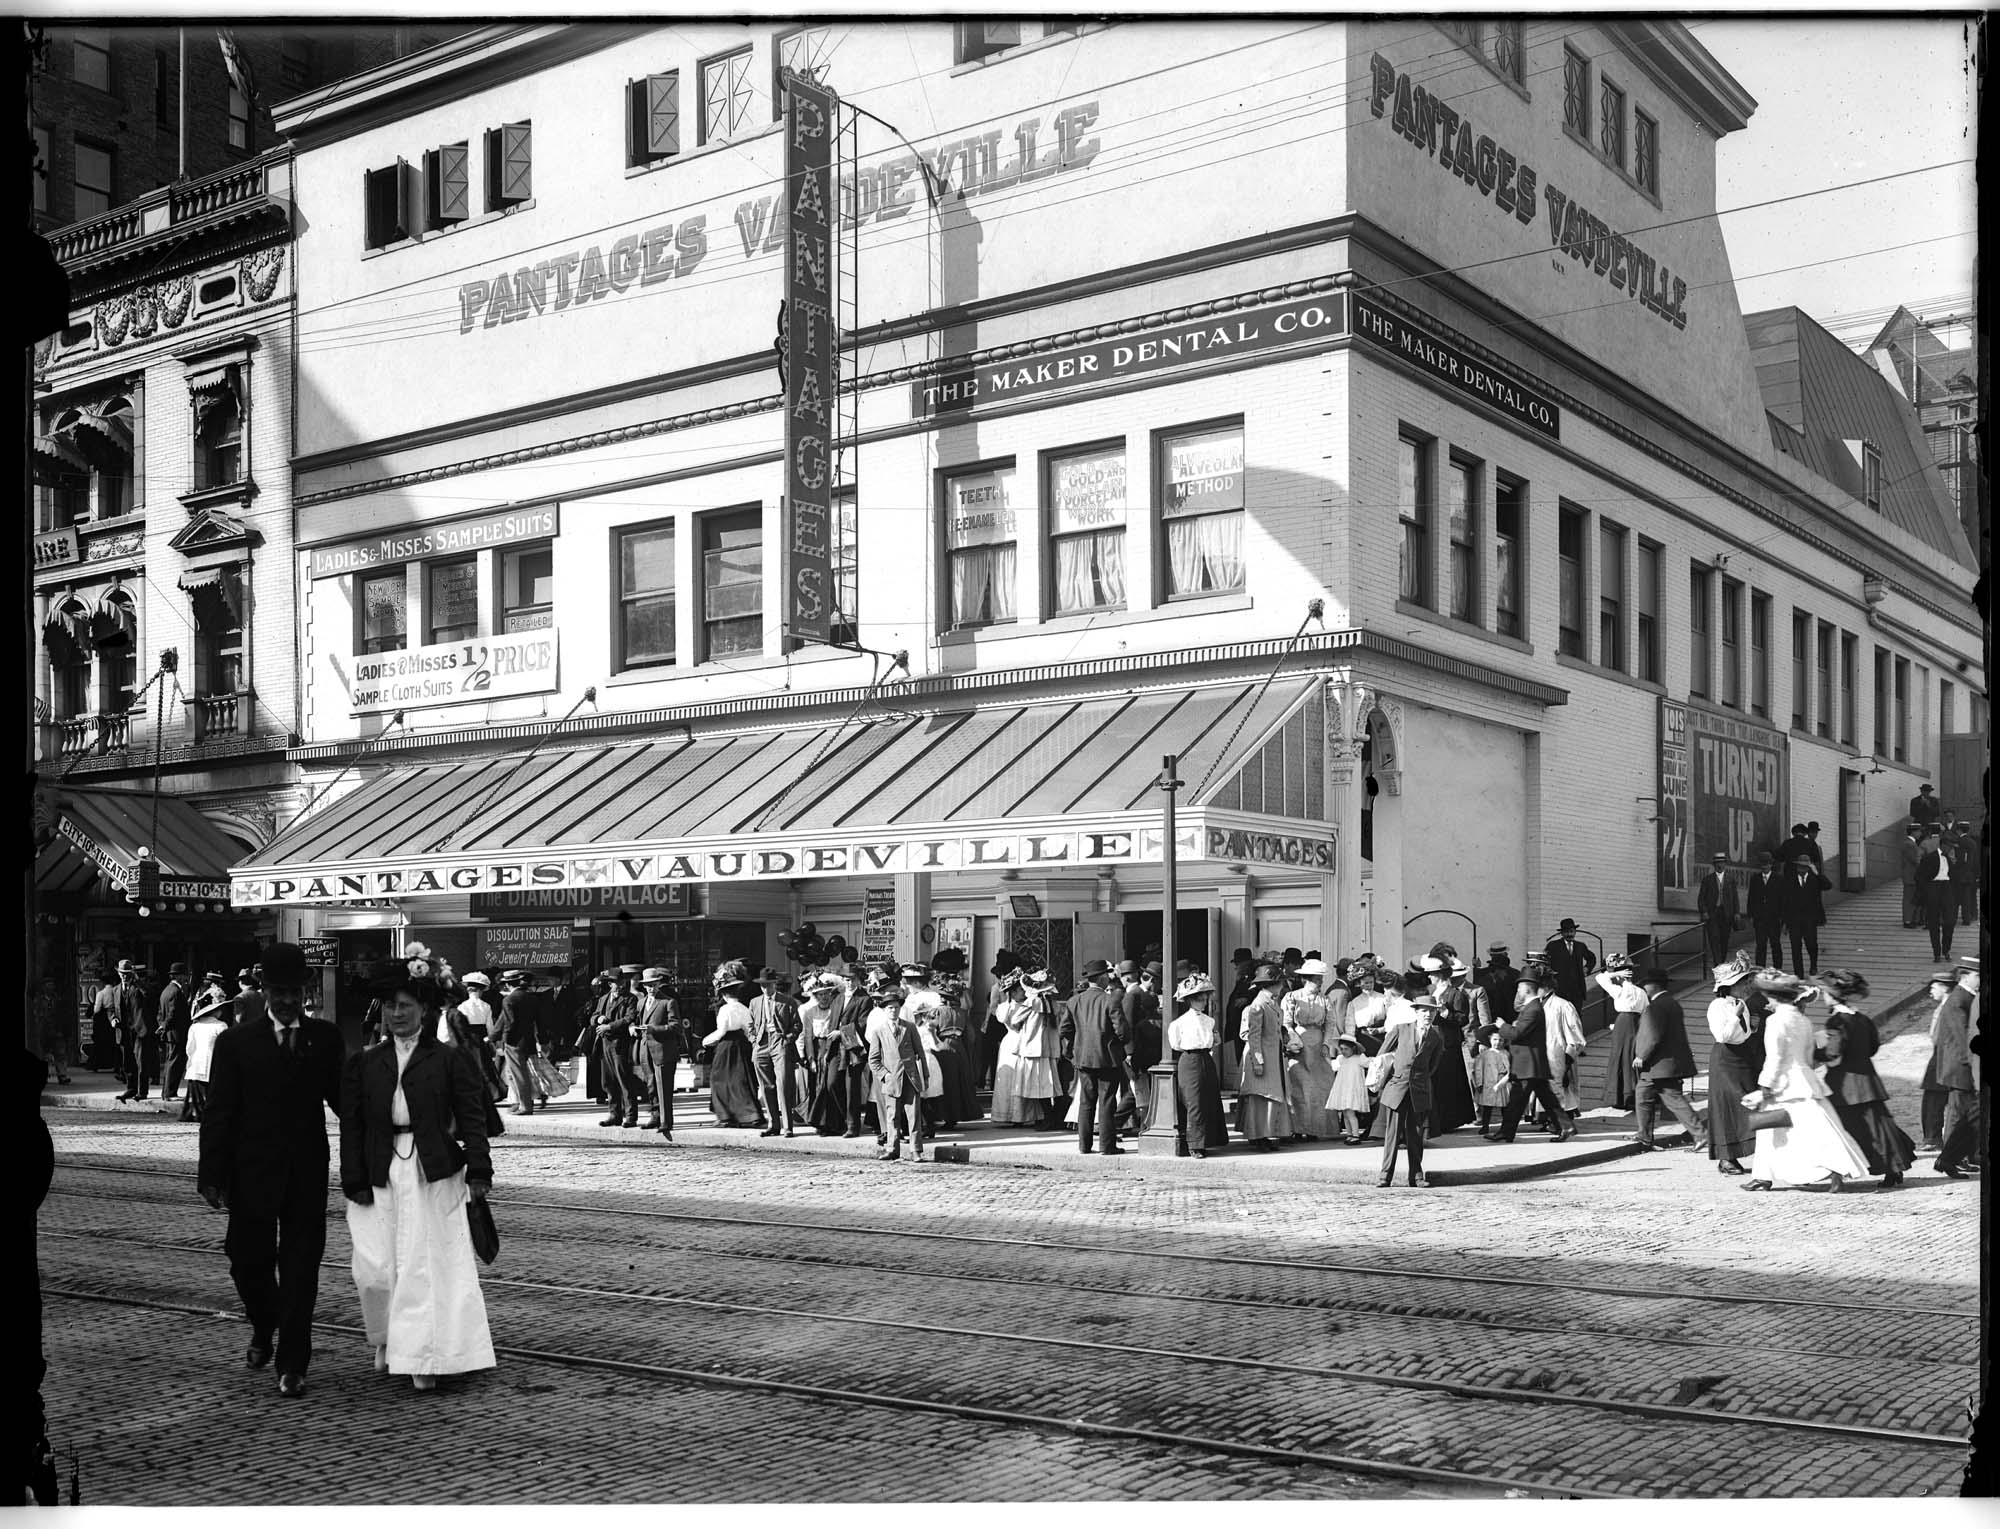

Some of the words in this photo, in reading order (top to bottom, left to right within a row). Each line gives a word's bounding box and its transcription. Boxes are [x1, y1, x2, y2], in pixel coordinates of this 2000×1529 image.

[1370, 52, 1536, 226] PANTAGES
[1545, 183, 1687, 331] VAUDEVILLE
[461, 214, 707, 334] PANTAGES
[736, 100, 1100, 258] VDEVILLE
[793, 93, 828, 621] PANTAGES
[922, 378, 979, 406] THE
[992, 354, 1099, 391] MAKER
[1112, 322, 1259, 368] DENTAL
[1274, 306, 1333, 335] CO.
[1359, 306, 1393, 342] THE
[1401, 329, 1459, 378] MAKER
[1464, 364, 1525, 412] DENTAL
[1529, 401, 1553, 428] CO.
[1176, 476, 1233, 498] METHOD
[316, 547, 368, 573] LADIES
[381, 535, 432, 560] MISSES
[436, 526, 502, 551] SAMPLE
[505, 512, 553, 538] SUITS
[510, 616, 548, 629] RETAILED
[356, 661, 396, 681] LADIES
[409, 653, 457, 674] MISSES
[493, 641, 551, 677] PRICE
[353, 688, 390, 706] SAMPLE
[391, 683, 421, 701] CLOTH
[424, 680, 453, 698] SUITS
[1664, 777, 1687, 797] JUNE
[1699, 737, 1777, 806] TURNED
[62, 820, 82, 843] CITY
[96, 849, 129, 885] THEATR
[1208, 829, 1329, 866] PANTAGES
[1728, 807, 1754, 864] UP
[163, 883, 191, 897] CITY
[269, 863, 566, 900] PANTAGES
[617, 832, 1132, 881] VAUDEVILLE
[508, 887, 593, 907] DIAMOND
[487, 927, 541, 942] DISOLUTION
[543, 925, 569, 940] SALE
[499, 951, 530, 966] Jewelry
[530, 949, 569, 964] Business
